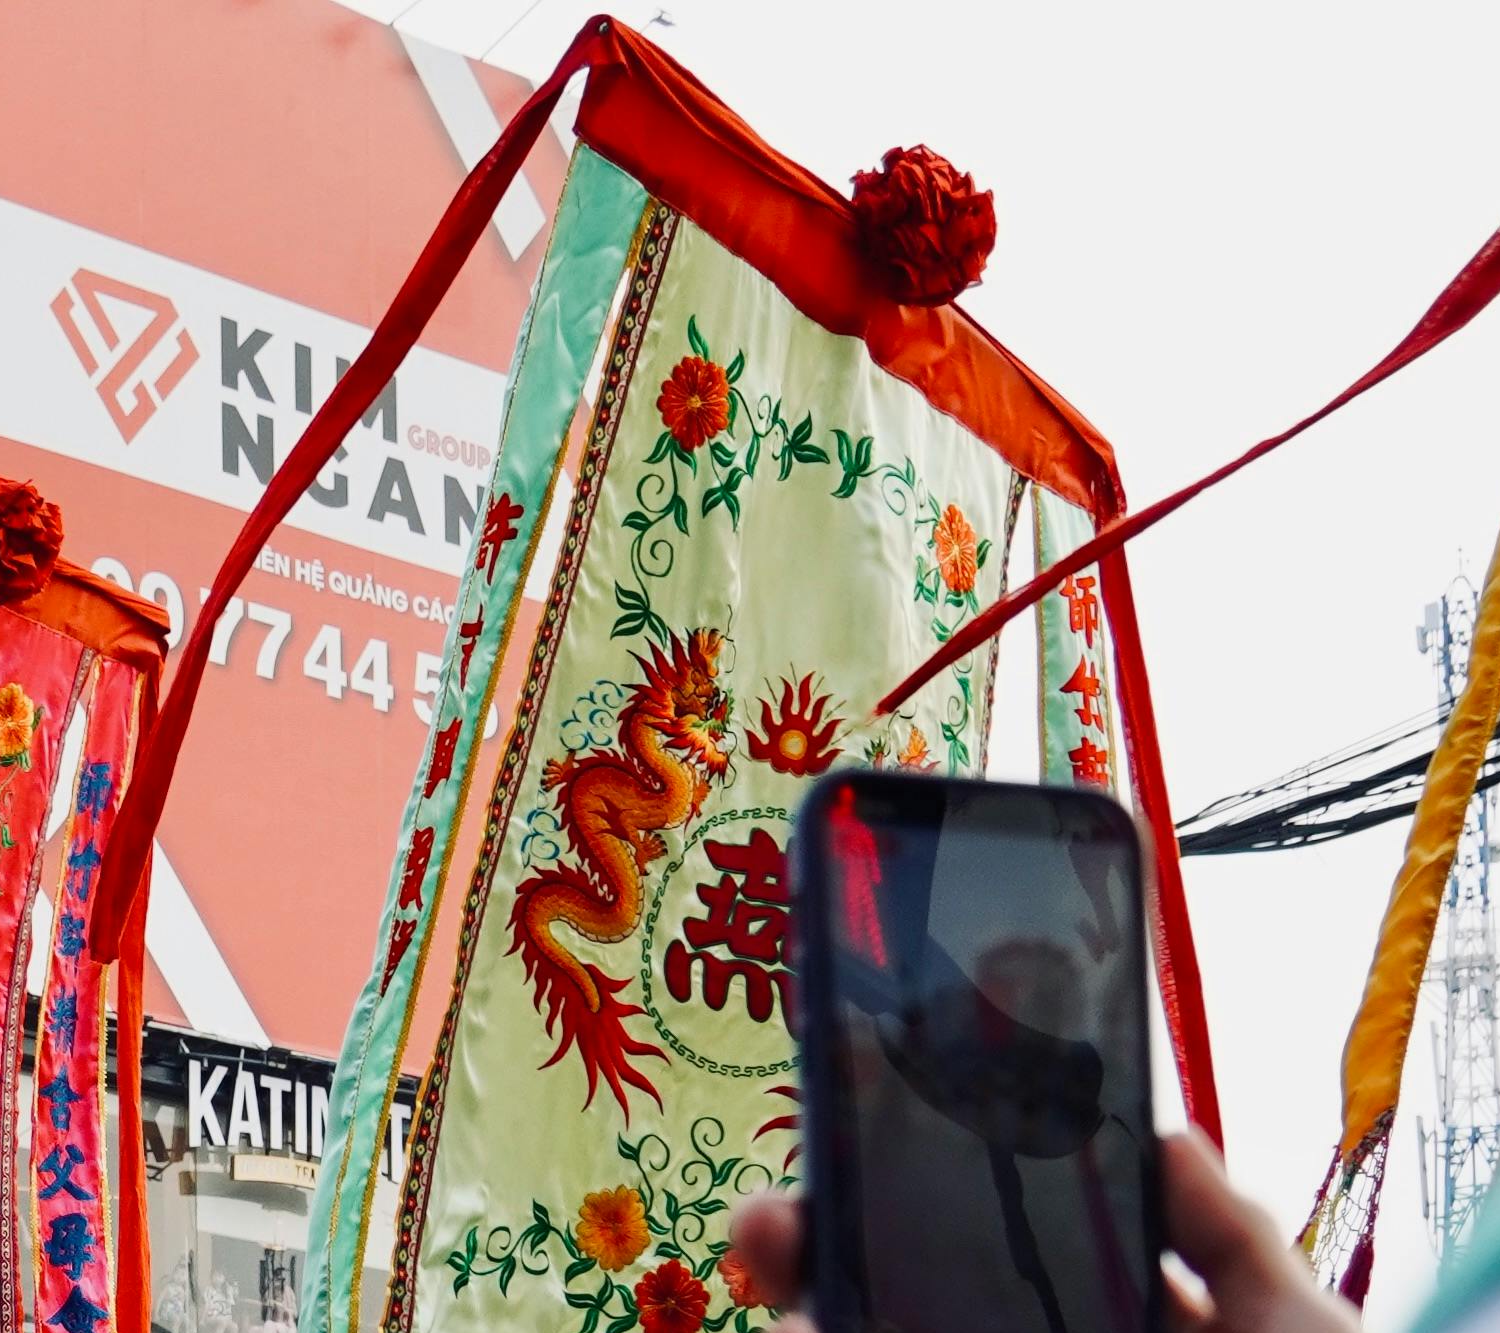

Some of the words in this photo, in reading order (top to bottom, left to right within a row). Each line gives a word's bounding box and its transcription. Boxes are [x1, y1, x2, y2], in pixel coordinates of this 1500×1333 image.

[406, 424, 492, 471] GROUP
[253, 543, 291, 579] IÊN
[294, 558, 325, 593] HỆ
[328, 570, 409, 613] QUẢNG
[188, 1058, 412, 1185] KATINT
